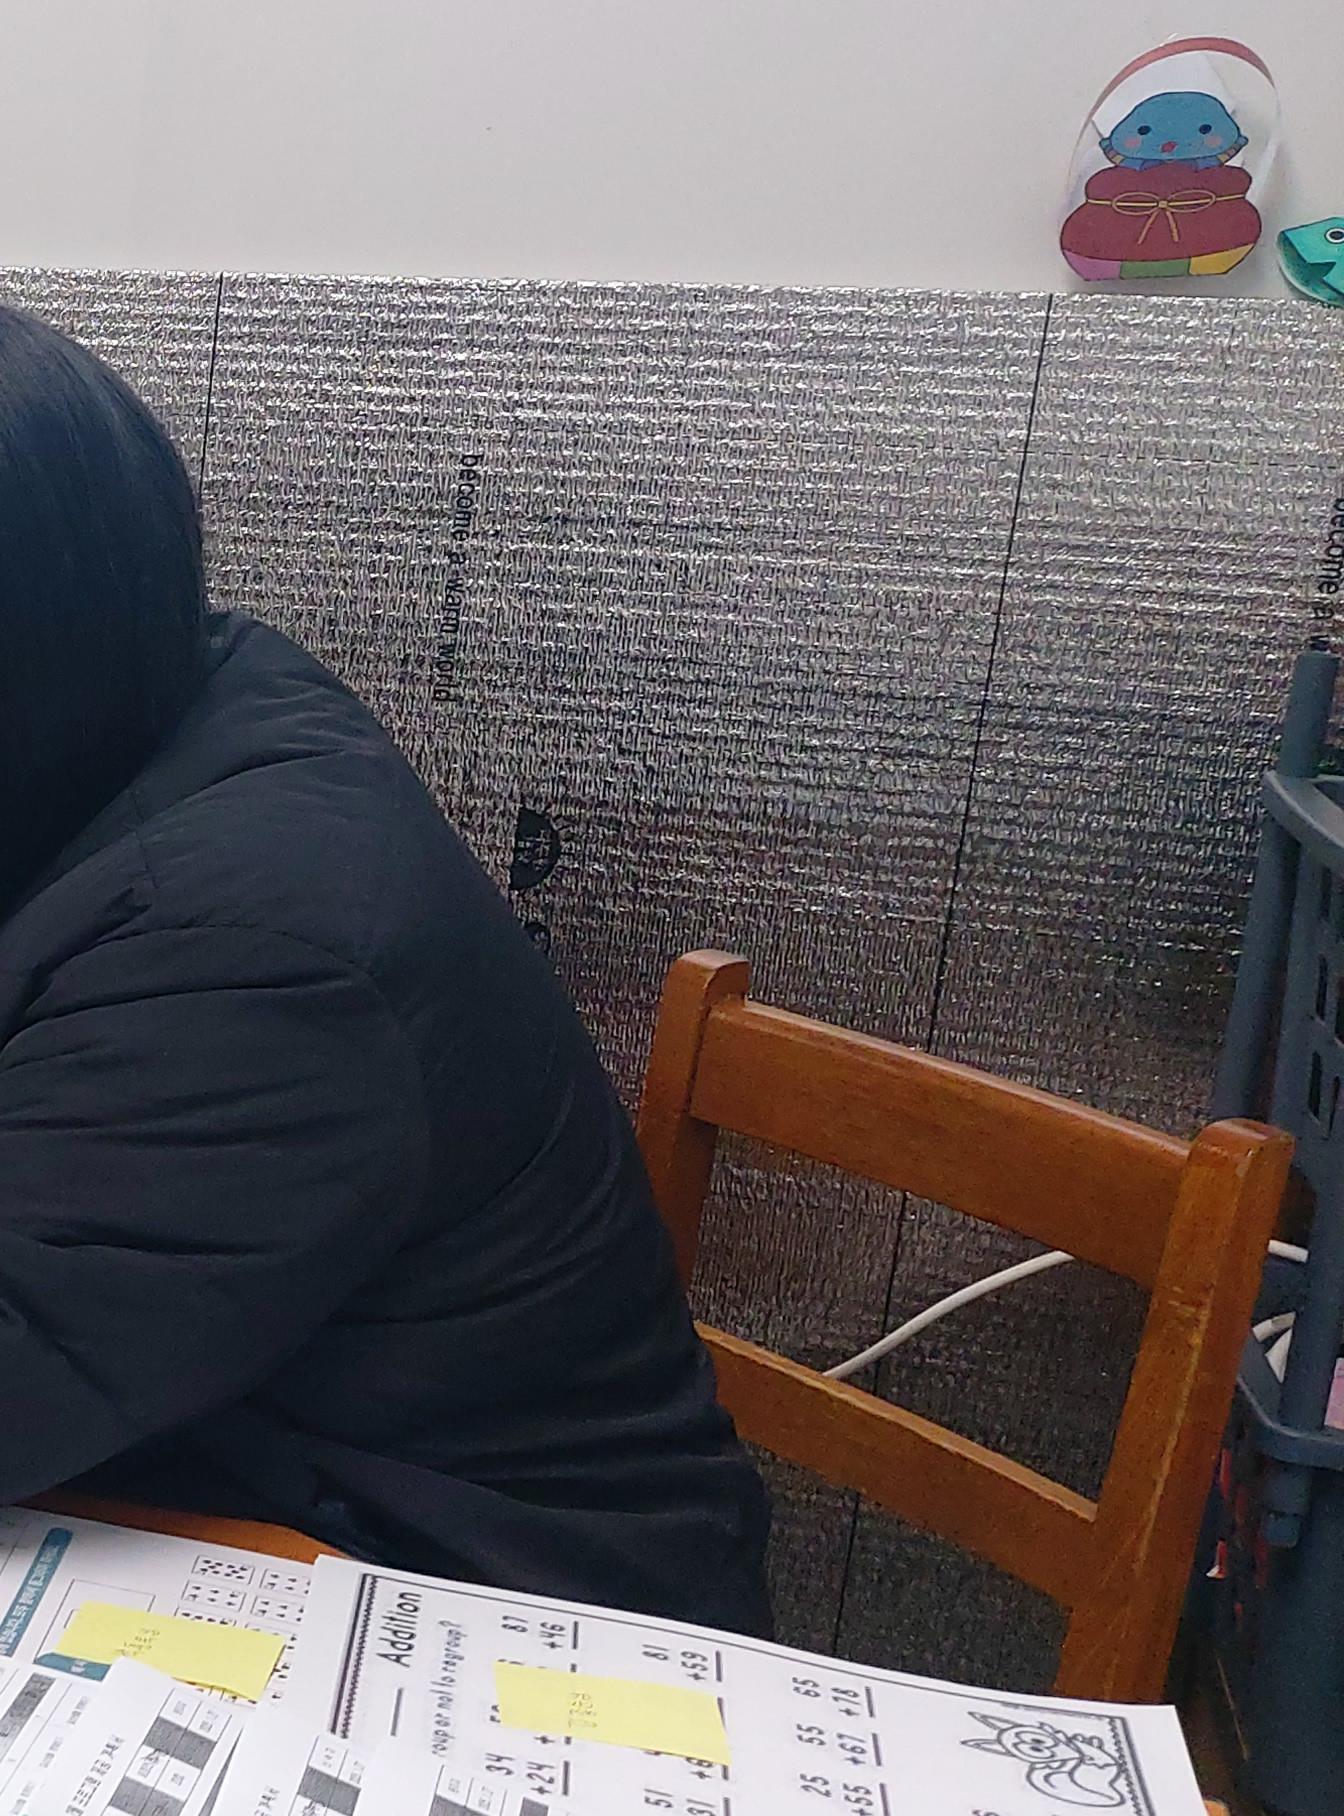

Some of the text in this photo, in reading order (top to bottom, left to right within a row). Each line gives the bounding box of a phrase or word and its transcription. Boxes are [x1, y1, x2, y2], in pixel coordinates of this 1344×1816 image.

[452, 455, 484, 541] become
[377, 1592, 422, 1668] Addition
[502, 1615, 528, 1633] 87
[642, 1644, 670, 1661] 81
[796, 1723, 826, 1746] 55
[485, 1753, 515, 1776] 34
[526, 1761, 556, 1795] +24
[799, 1773, 832, 1798] 25
[644, 1788, 673, 1809] 51
